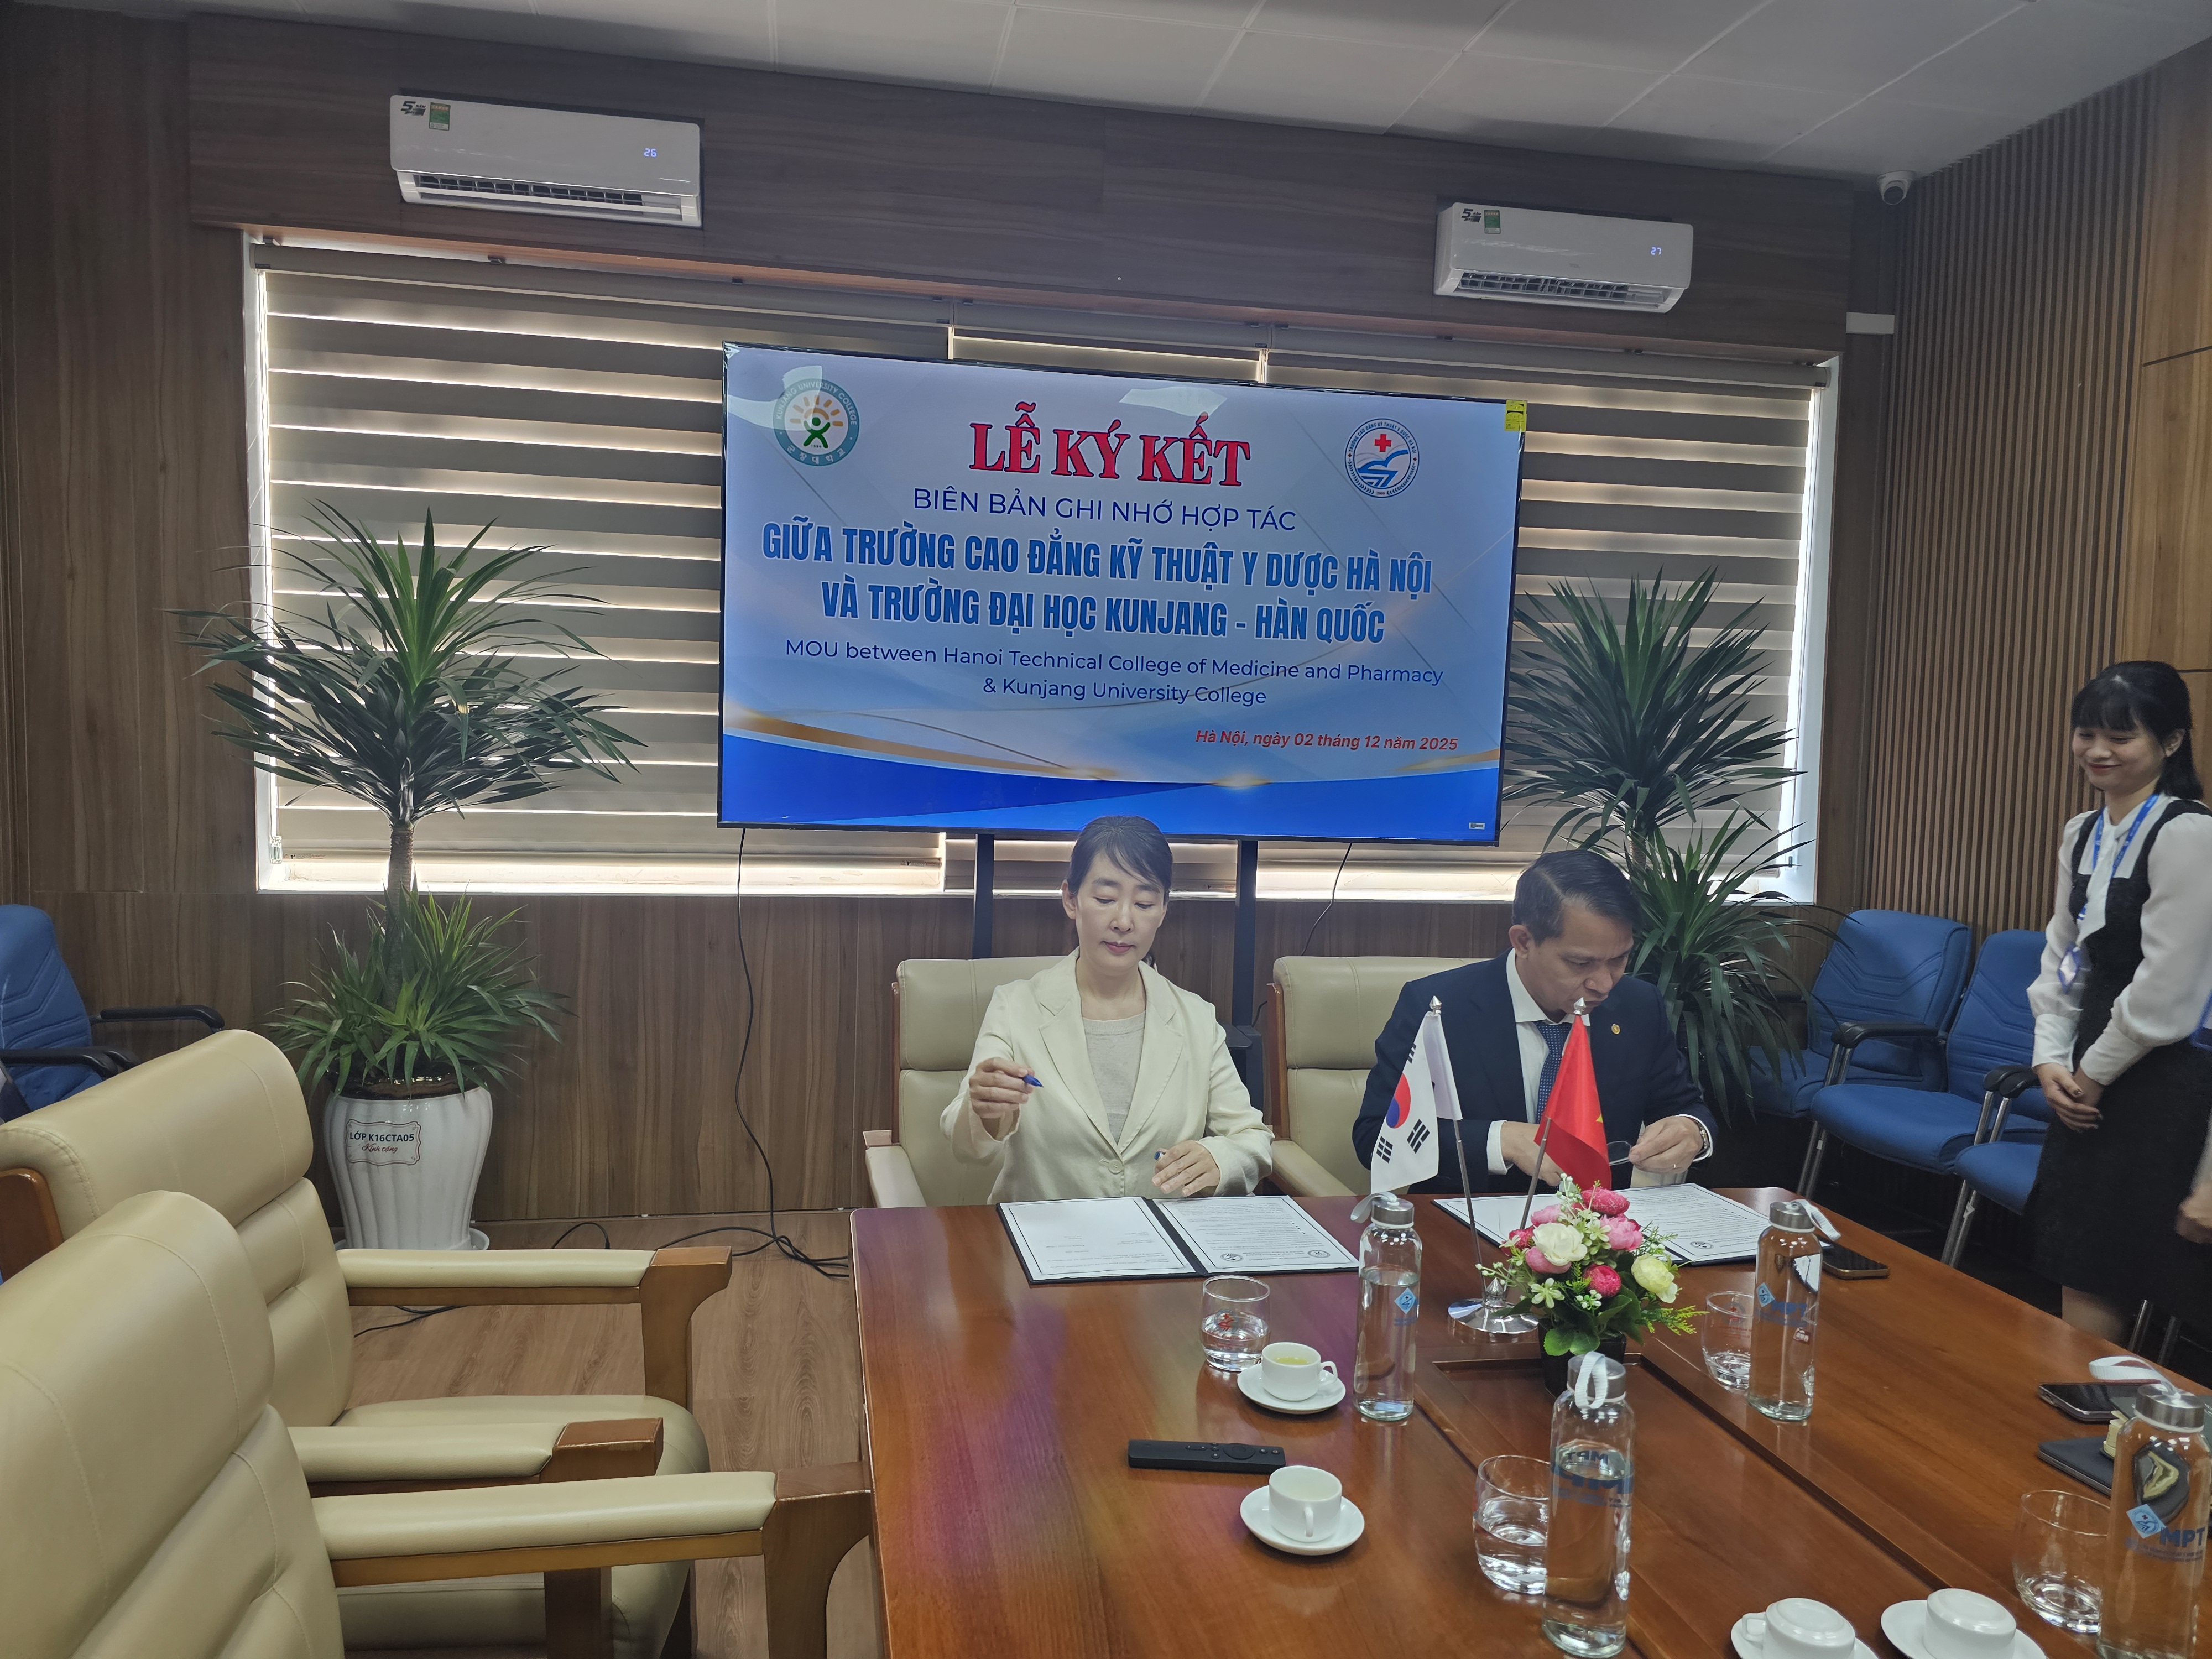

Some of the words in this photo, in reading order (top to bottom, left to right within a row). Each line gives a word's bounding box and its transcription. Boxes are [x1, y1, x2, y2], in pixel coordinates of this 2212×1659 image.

[401, 101, 416, 111] 5
[644, 148, 657, 158] 26
[1461, 208, 1474, 218] 5
[1650, 247, 1661, 255] 27
[776, 388, 797, 419] KUNJANG
[799, 382, 838, 393] UNIVERSITY
[838, 392, 857, 425] COLLEGE
[969, 401, 1040, 473] LỄ
[1051, 419, 1131, 479] KÝ
[1137, 412, 1250, 486] KẾT
[915, 486, 978, 512] BIÊN
[990, 488, 1045, 516] BẢN
[1056, 498, 1101, 520] GHI
[1113, 499, 1172, 524] NHỚ
[1182, 504, 1238, 531] HỢP
[1248, 507, 1296, 531] TÁC
[764, 516, 832, 561] GIỮA
[843, 521, 954, 568] TRƯỜNG
[966, 536, 1018, 572] CAO
[1028, 528, 1099, 577] ĐẲNG
[1110, 538, 1143, 579] KỸ
[1152, 542, 1233, 590] THUẬT
[1243, 552, 1258, 585] Y
[1266, 552, 1337, 595] DƯỢC
[1347, 550, 1379, 590] HÀ
[1390, 552, 1431, 599] NỘI
[822, 575, 858, 618] VÀ
[869, 578, 979, 624] TRƯỜNG
[989, 592, 1033, 633] ĐẠI
[1044, 595, 1095, 637] HỌC
[1106, 598, 1227, 636] KUNJANG
[1256, 598, 1307, 639] HÀN
[1317, 602, 1384, 643] QUỐC
[787, 640, 837, 656] MOU
[847, 642, 936, 662] between
[945, 648, 1002, 665] Hanoi
[1009, 651, 1102, 669] Technical
[1109, 656, 1181, 676] College
[1188, 659, 1207, 674] of
[1213, 660, 1298, 679] Medicine
[1305, 664, 1340, 679] and
[1348, 665, 1443, 686] Pharmacy
[983, 678, 996, 692] &
[1004, 679, 1085, 700] Kunjang
[1094, 683, 1190, 704] University
[1194, 686, 1266, 707] College
[1196, 730, 1216, 742] Hà
[1220, 730, 1248, 746] Nội,
[1253, 732, 1290, 748] ngày
[1295, 733, 1313, 745] 02
[1318, 734, 1360, 750] tháng
[1365, 736, 1380, 748] 12
[1384, 737, 1415, 749] năm
[1419, 738, 1458, 750] 2025
[349, 1130, 367, 1140] LỚP
[368, 1134, 414, 1142] K16CTA05
